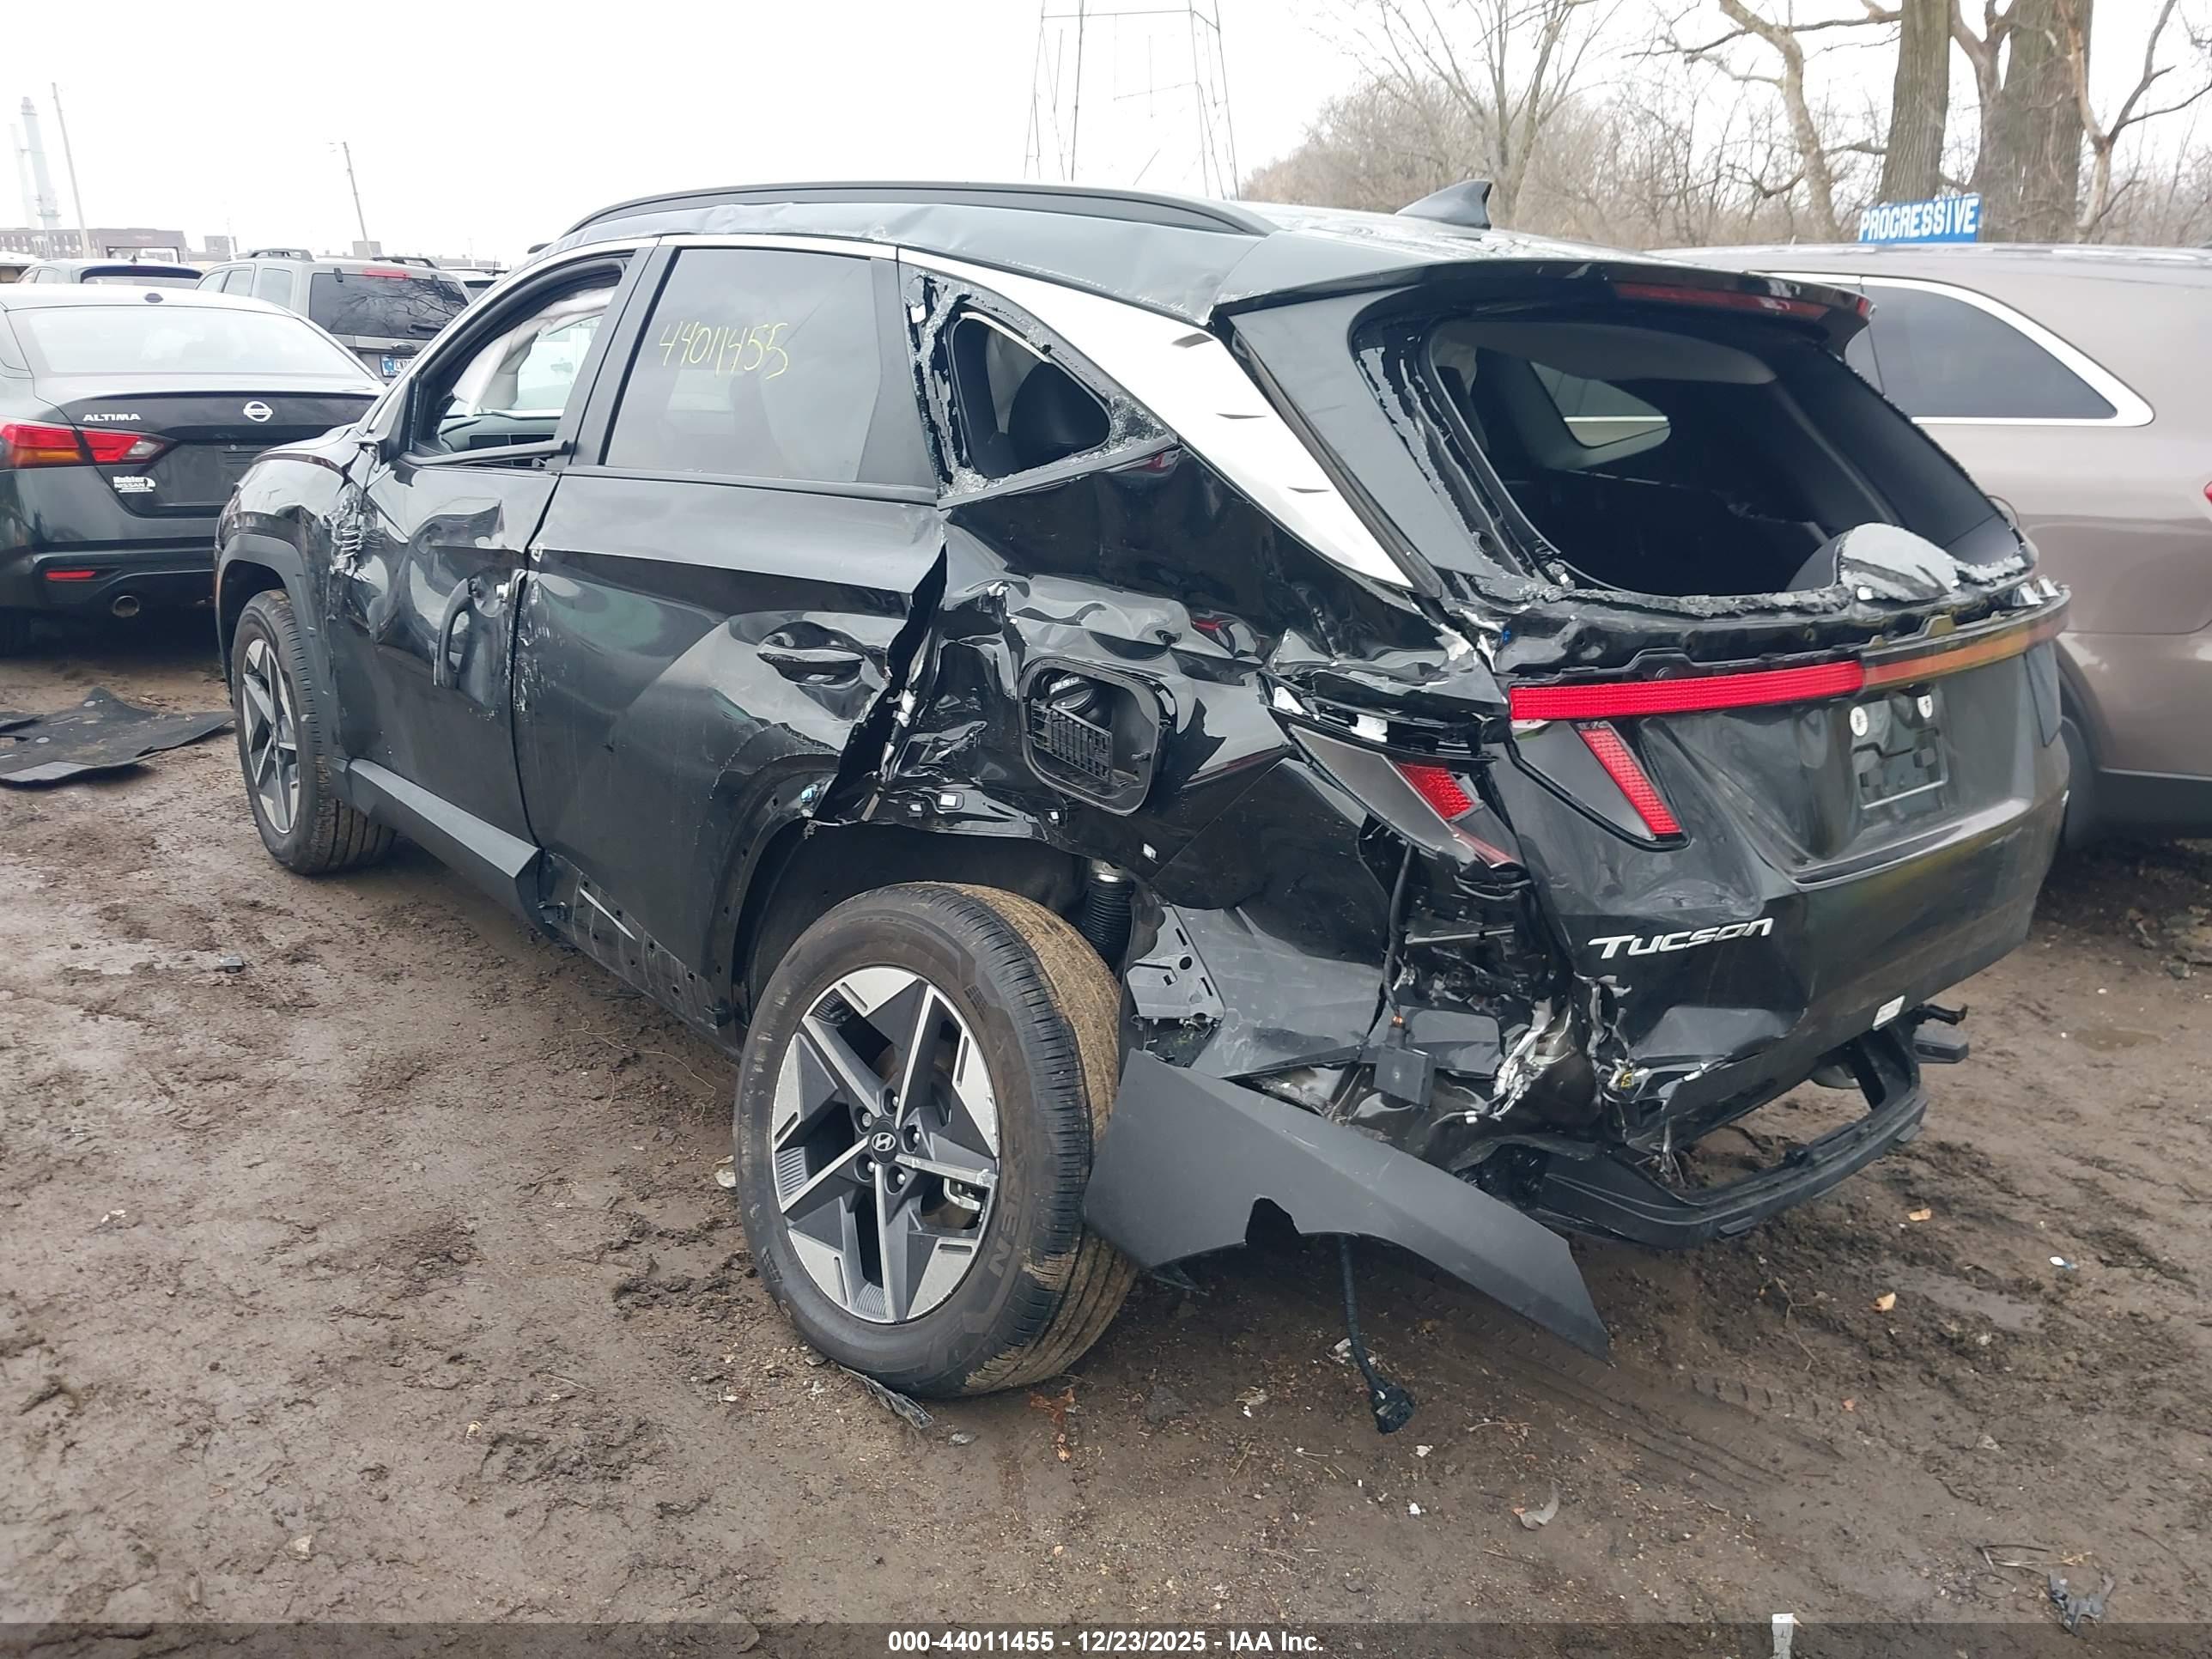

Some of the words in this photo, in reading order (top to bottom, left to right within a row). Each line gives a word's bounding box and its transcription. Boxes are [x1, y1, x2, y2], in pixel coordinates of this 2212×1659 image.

[1858, 198, 1979, 241] PROGRESSIVE
[659, 320, 789, 380] 44011455
[82, 413, 142, 422] ALTIMA
